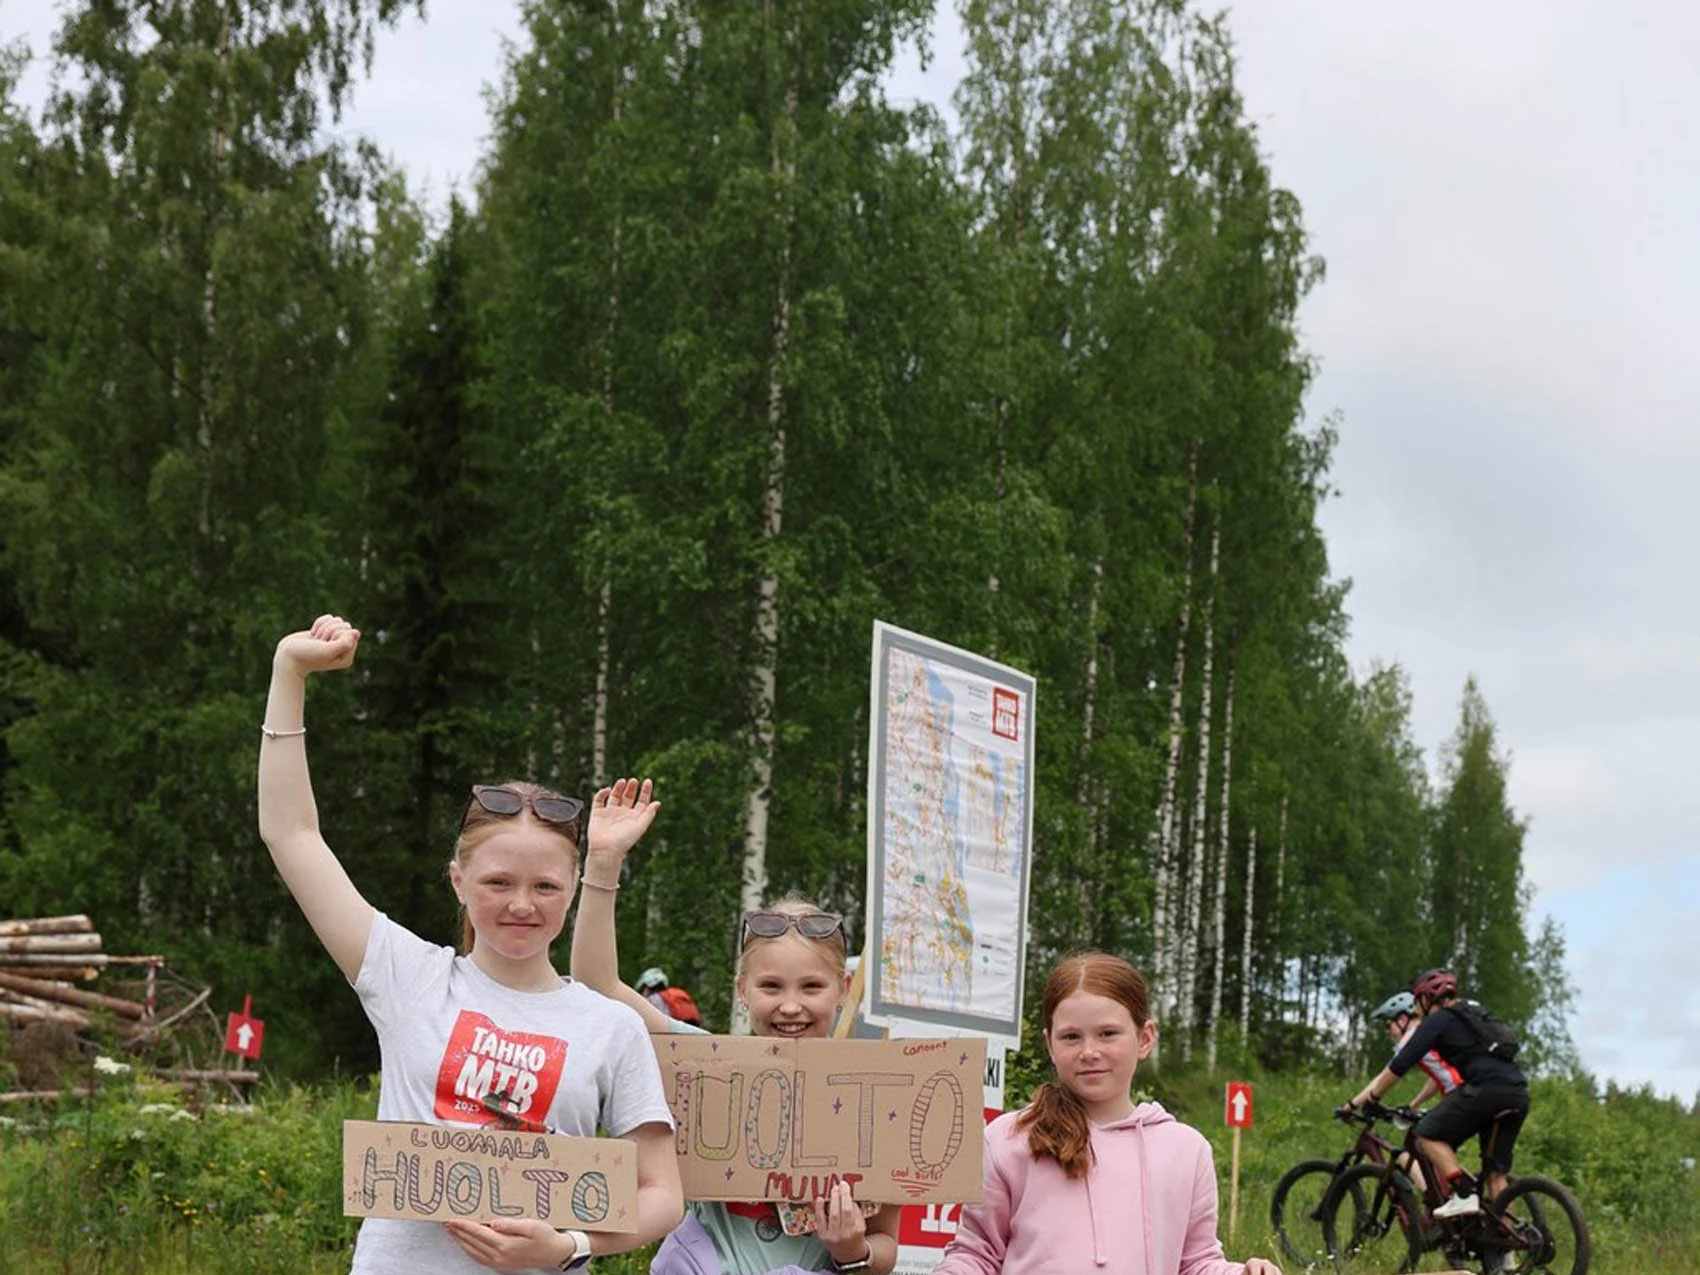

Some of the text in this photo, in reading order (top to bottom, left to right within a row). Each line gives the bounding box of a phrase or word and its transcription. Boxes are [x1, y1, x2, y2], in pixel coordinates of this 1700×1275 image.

[472, 1026, 546, 1072] TAHKO
[454, 1055, 538, 1114] MTB
[411, 1128, 550, 1158] LUOMALA
[363, 1147, 609, 1223] HUOLTO
